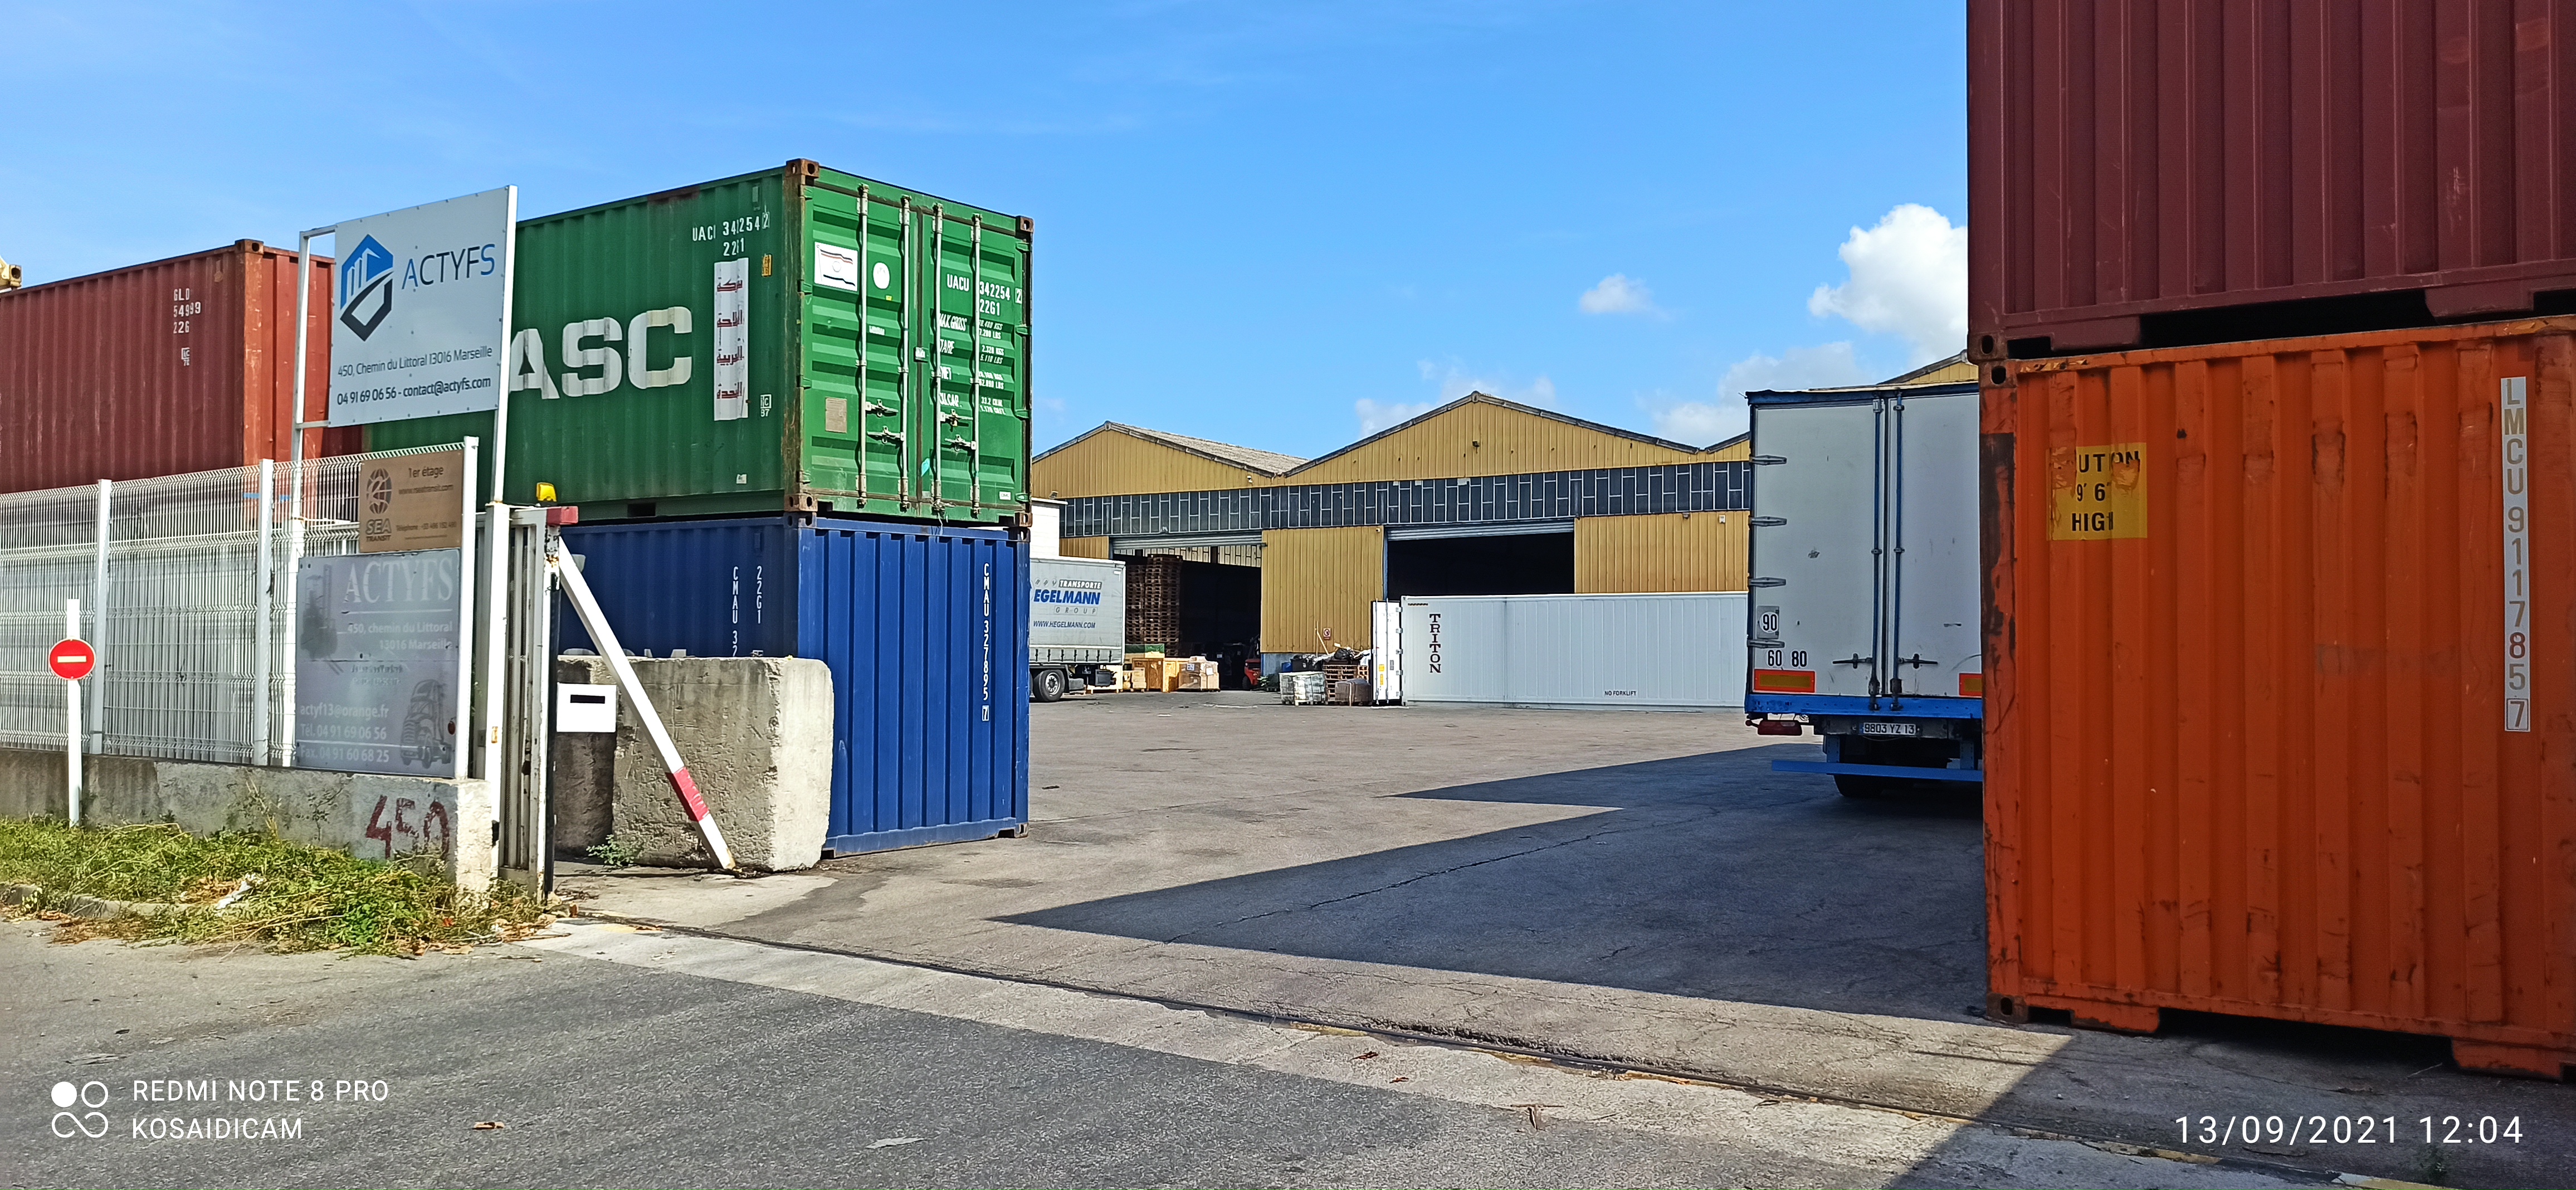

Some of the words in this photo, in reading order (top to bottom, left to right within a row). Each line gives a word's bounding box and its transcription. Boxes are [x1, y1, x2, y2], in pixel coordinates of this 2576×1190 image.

[402, 243, 496, 290] ACTYFS
[947, 273, 969, 291] UACU
[979, 281, 1011, 301] 342254
[979, 299, 1001, 316] 22G1
[338, 365, 355, 377] 450,
[356, 361, 386, 375] Chemin
[387, 359, 398, 370] du
[399, 354, 428, 369] Littoral
[429, 350, 452, 365] 13016
[453, 345, 492, 362] Marseille
[337, 393, 348, 405] 04
[350, 391, 358, 403] 91
[360, 390, 370, 402] 69
[373, 388, 384, 401] 06
[386, 387, 397, 399] 56
[403, 377, 491, 396] contact@actyfs.com
[2504, 378, 2525, 495] LMCU
[365, 518, 392, 535] SEA
[343, 557, 453, 603] ACTYFS
[1060, 580, 1101, 589] TRANSPORTE
[1033, 589, 1101, 605] EGELMANN
[2507, 506, 2526, 690] 911785
[347, 623, 367, 634] 450,
[368, 622, 401, 633] chemin
[403, 622, 416, 633] du
[418, 621, 452, 632] Littoral
[1033, 621, 1096, 629] WWW.HEGELMANN.COM
[1763, 614, 1778, 631] 90
[380, 640, 407, 650] 13016
[409, 638, 452, 650] Marseille
[1429, 613, 1442, 673] TRITON
[1768, 650, 1782, 667] 60
[1792, 651, 1807, 667] 80
[300, 703, 389, 722] actyf13@orange.fr
[300, 723, 315, 737] Tél.
[317, 724, 329, 737] 04
[330, 725, 341, 738] 91
[344, 726, 355, 739] 69
[360, 726, 372, 739] 06
[374, 727, 387, 740] 56
[1864, 723, 1887, 733] 9803
[1890, 724, 1901, 734] YZ
[1905, 724, 1915, 734] 13
[319, 747, 330, 759] 04
[333, 748, 344, 760] 91
[347, 749, 359, 761] 60
[362, 749, 374, 762] 68
[376, 750, 389, 763] 25
[366, 794, 450, 860] 450
